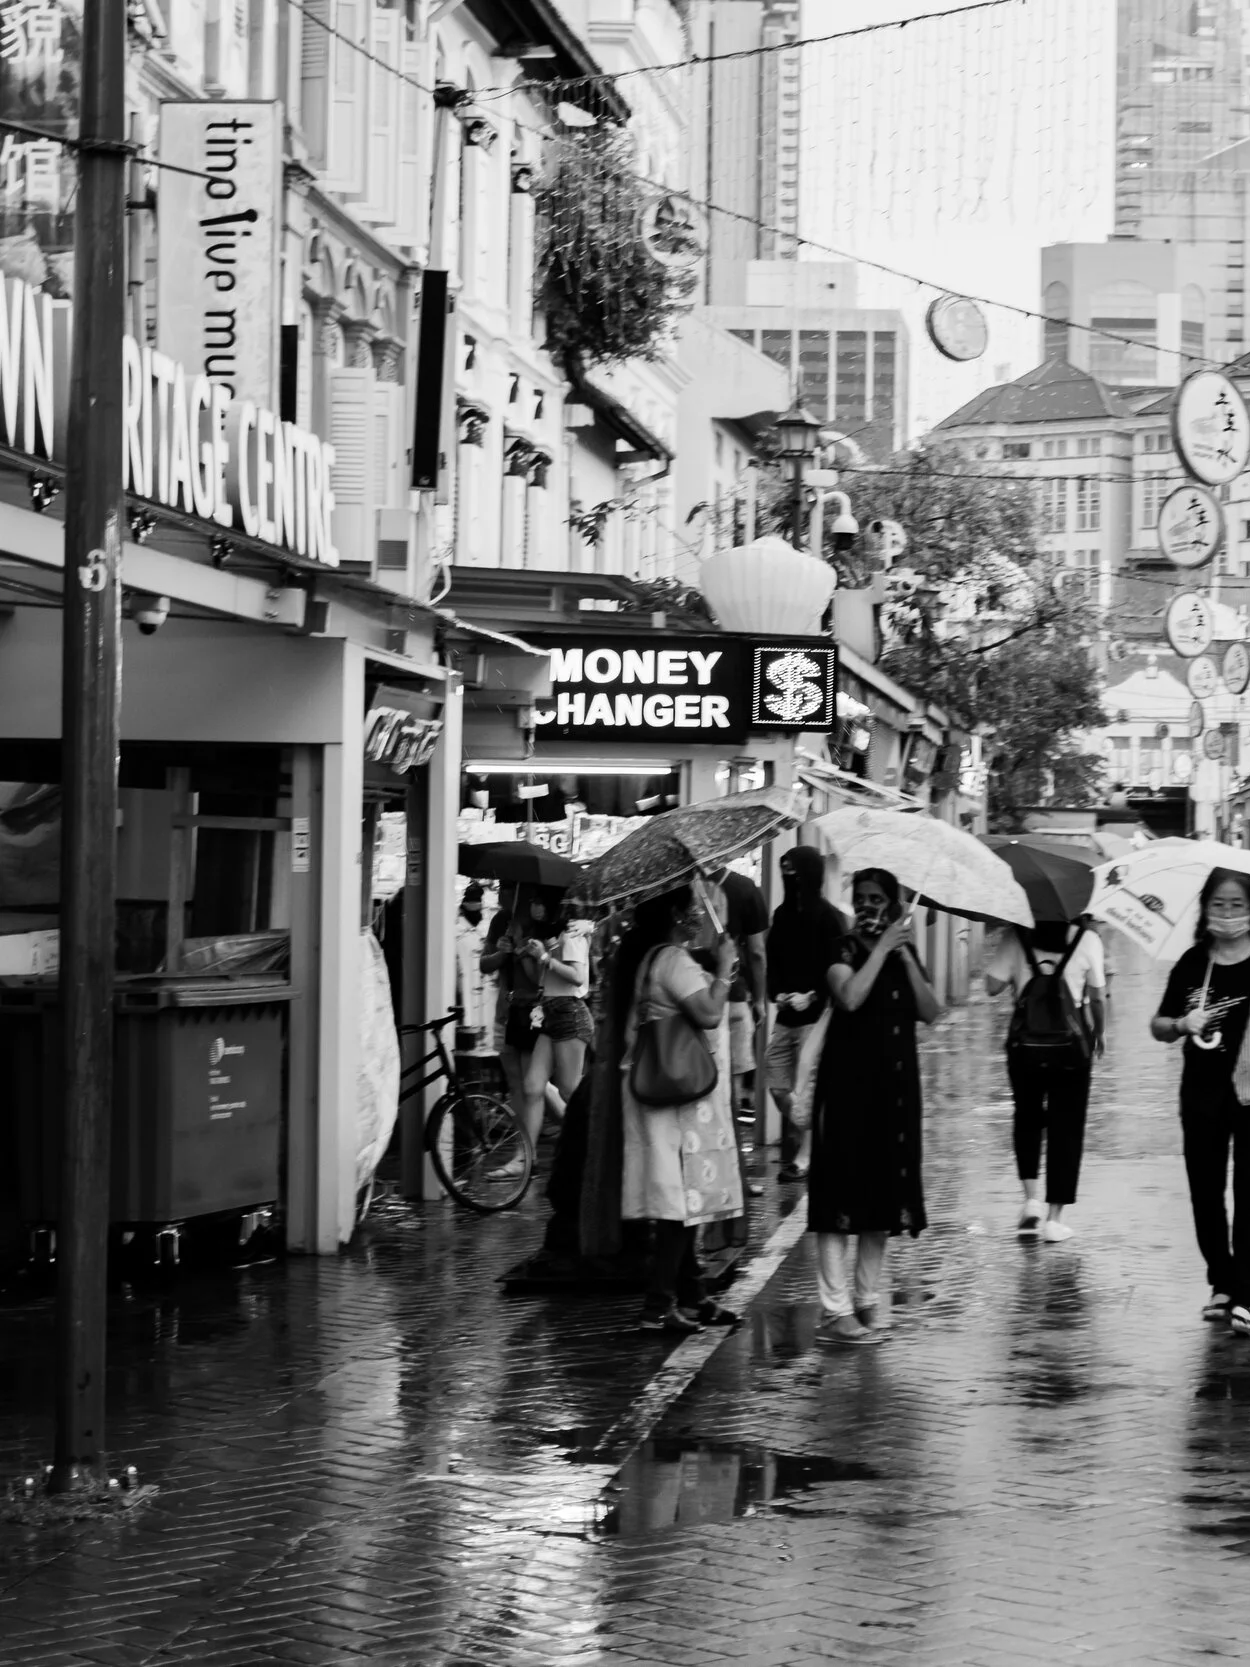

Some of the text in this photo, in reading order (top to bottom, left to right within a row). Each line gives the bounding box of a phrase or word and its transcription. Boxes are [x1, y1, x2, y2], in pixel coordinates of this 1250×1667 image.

[123, 334, 234, 528] RITAGE
[238, 402, 340, 568] CENTRE
[549, 647, 724, 686] MONEY
